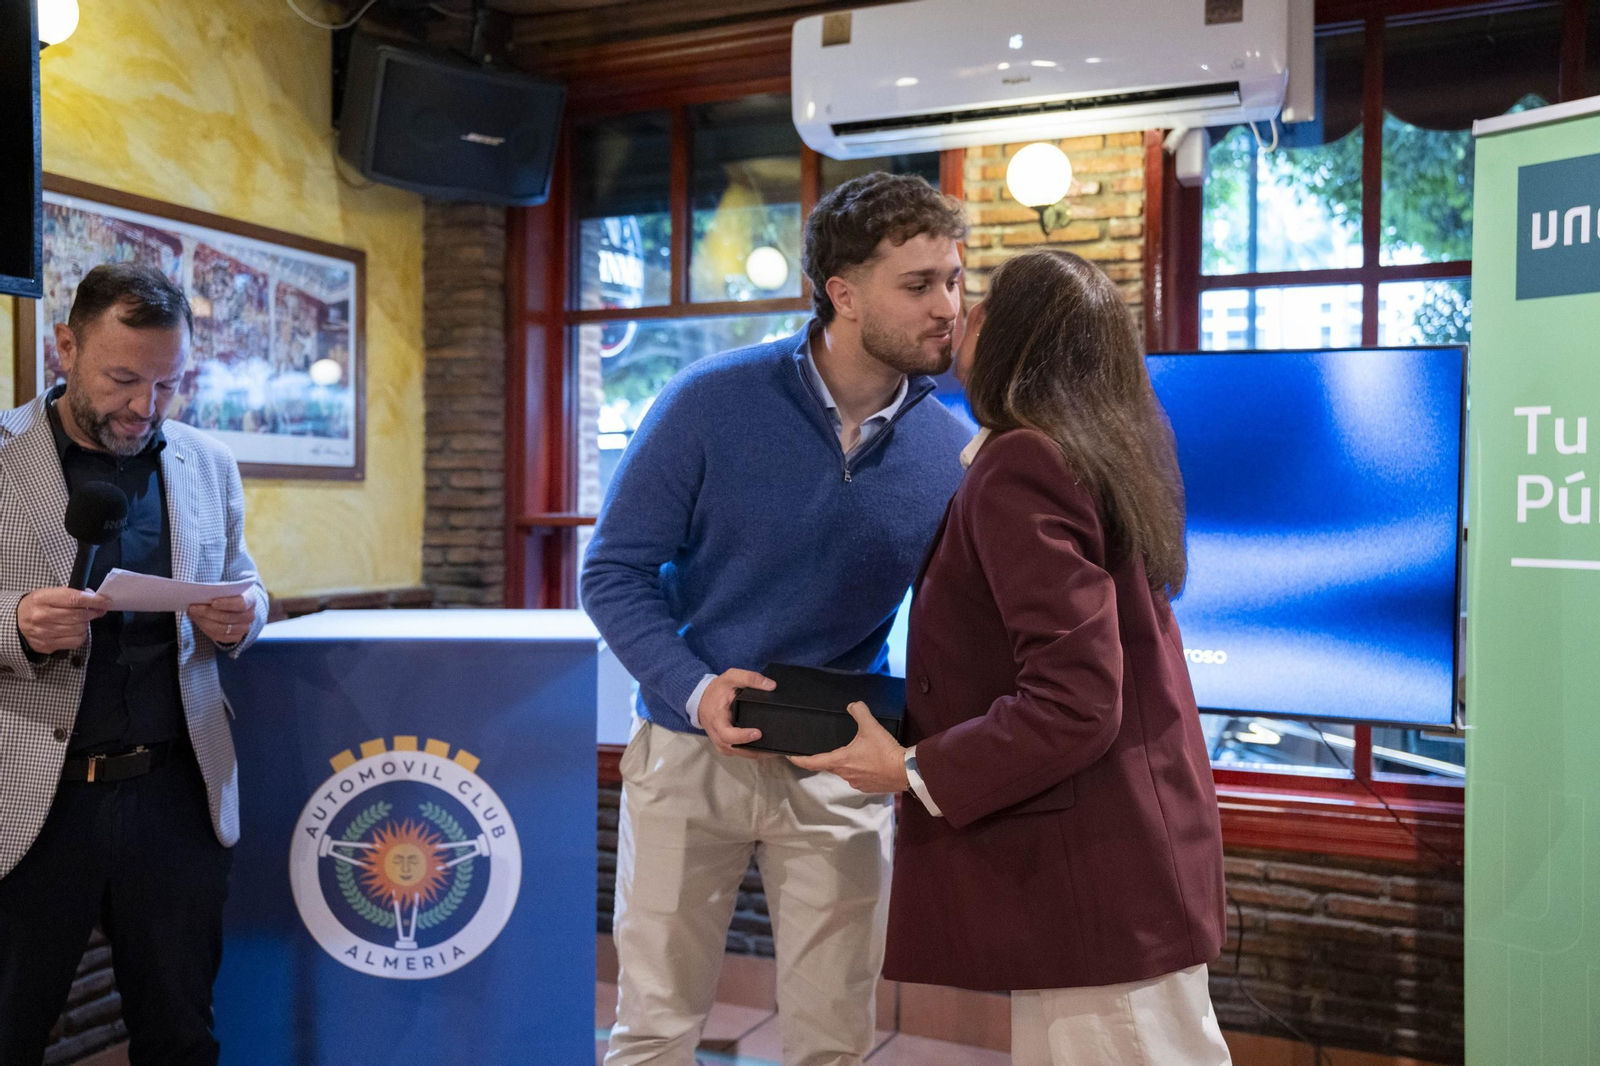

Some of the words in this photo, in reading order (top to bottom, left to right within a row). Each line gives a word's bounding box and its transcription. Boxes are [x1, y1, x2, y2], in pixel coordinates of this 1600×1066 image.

[1513, 405, 1588, 456] Tu
[1516, 470, 1600, 525] Pú
[305, 760, 442, 839] AUTOMOVIL
[457, 780, 506, 839] CLUB
[344, 944, 466, 971] ALMERIA
